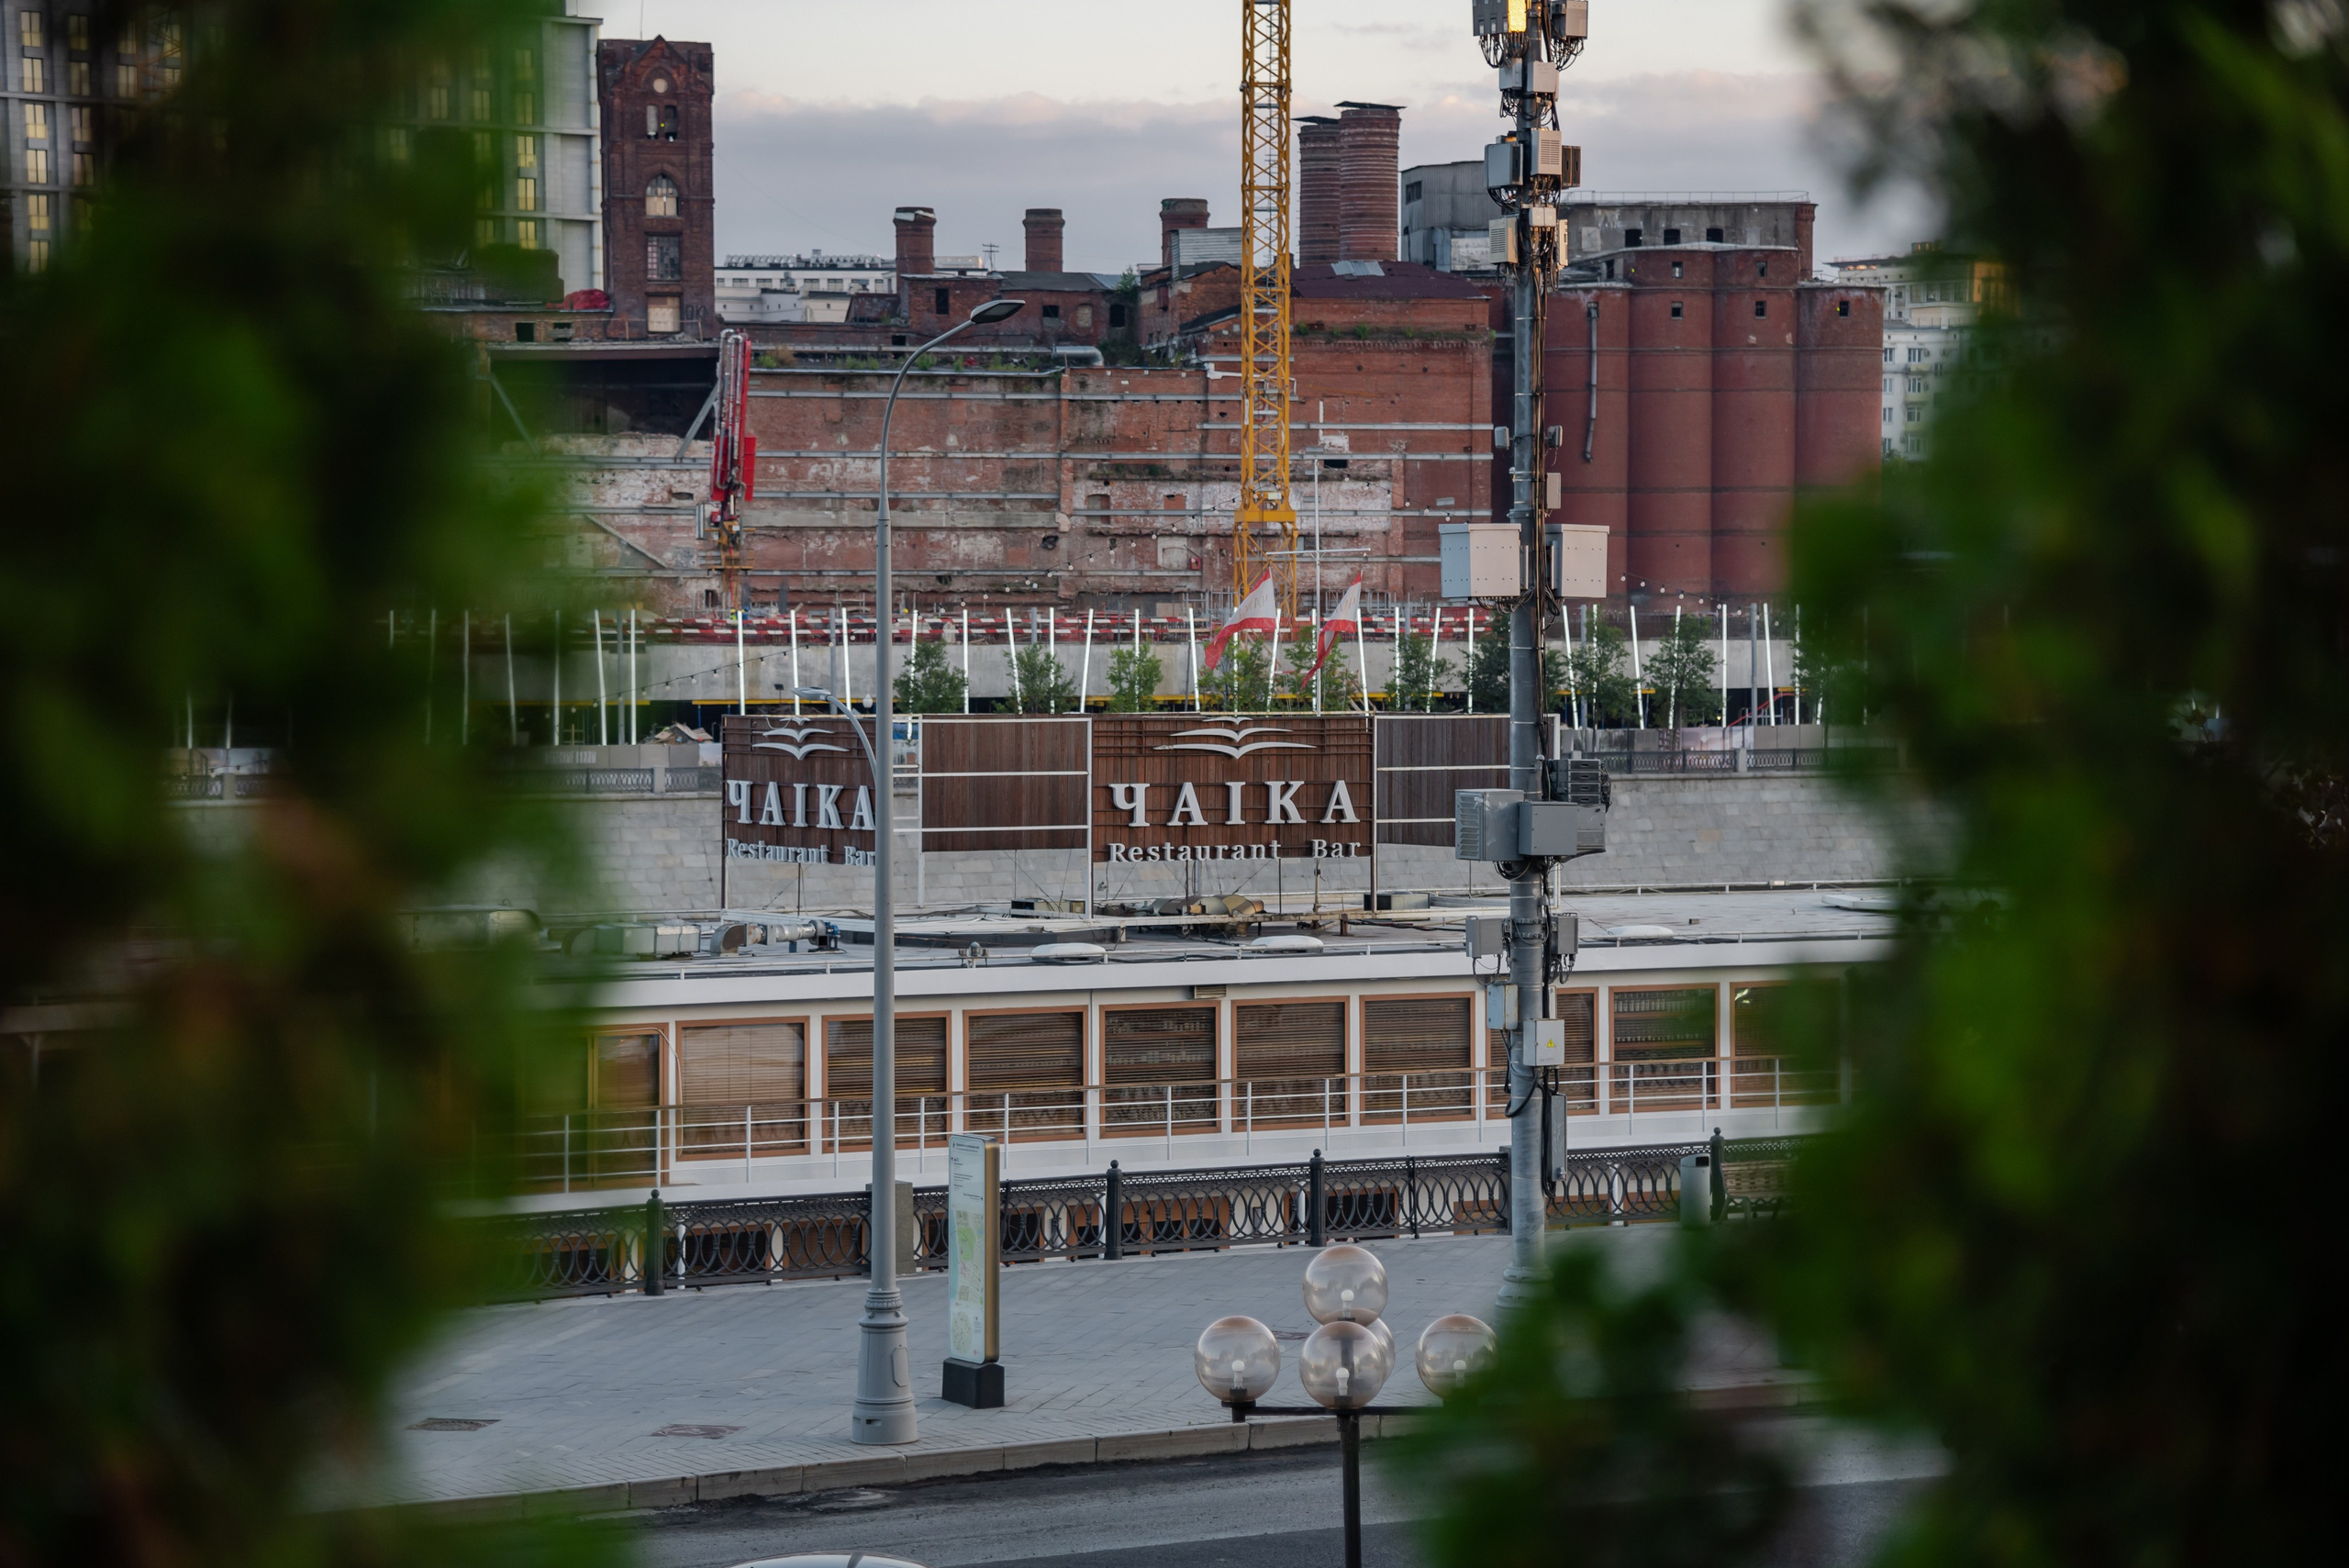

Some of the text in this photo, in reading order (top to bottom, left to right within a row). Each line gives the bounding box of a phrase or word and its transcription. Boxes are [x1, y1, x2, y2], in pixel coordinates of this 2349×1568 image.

[727, 838, 829, 864] Restaurant
[1108, 839, 1361, 863] Restaurant Bar
